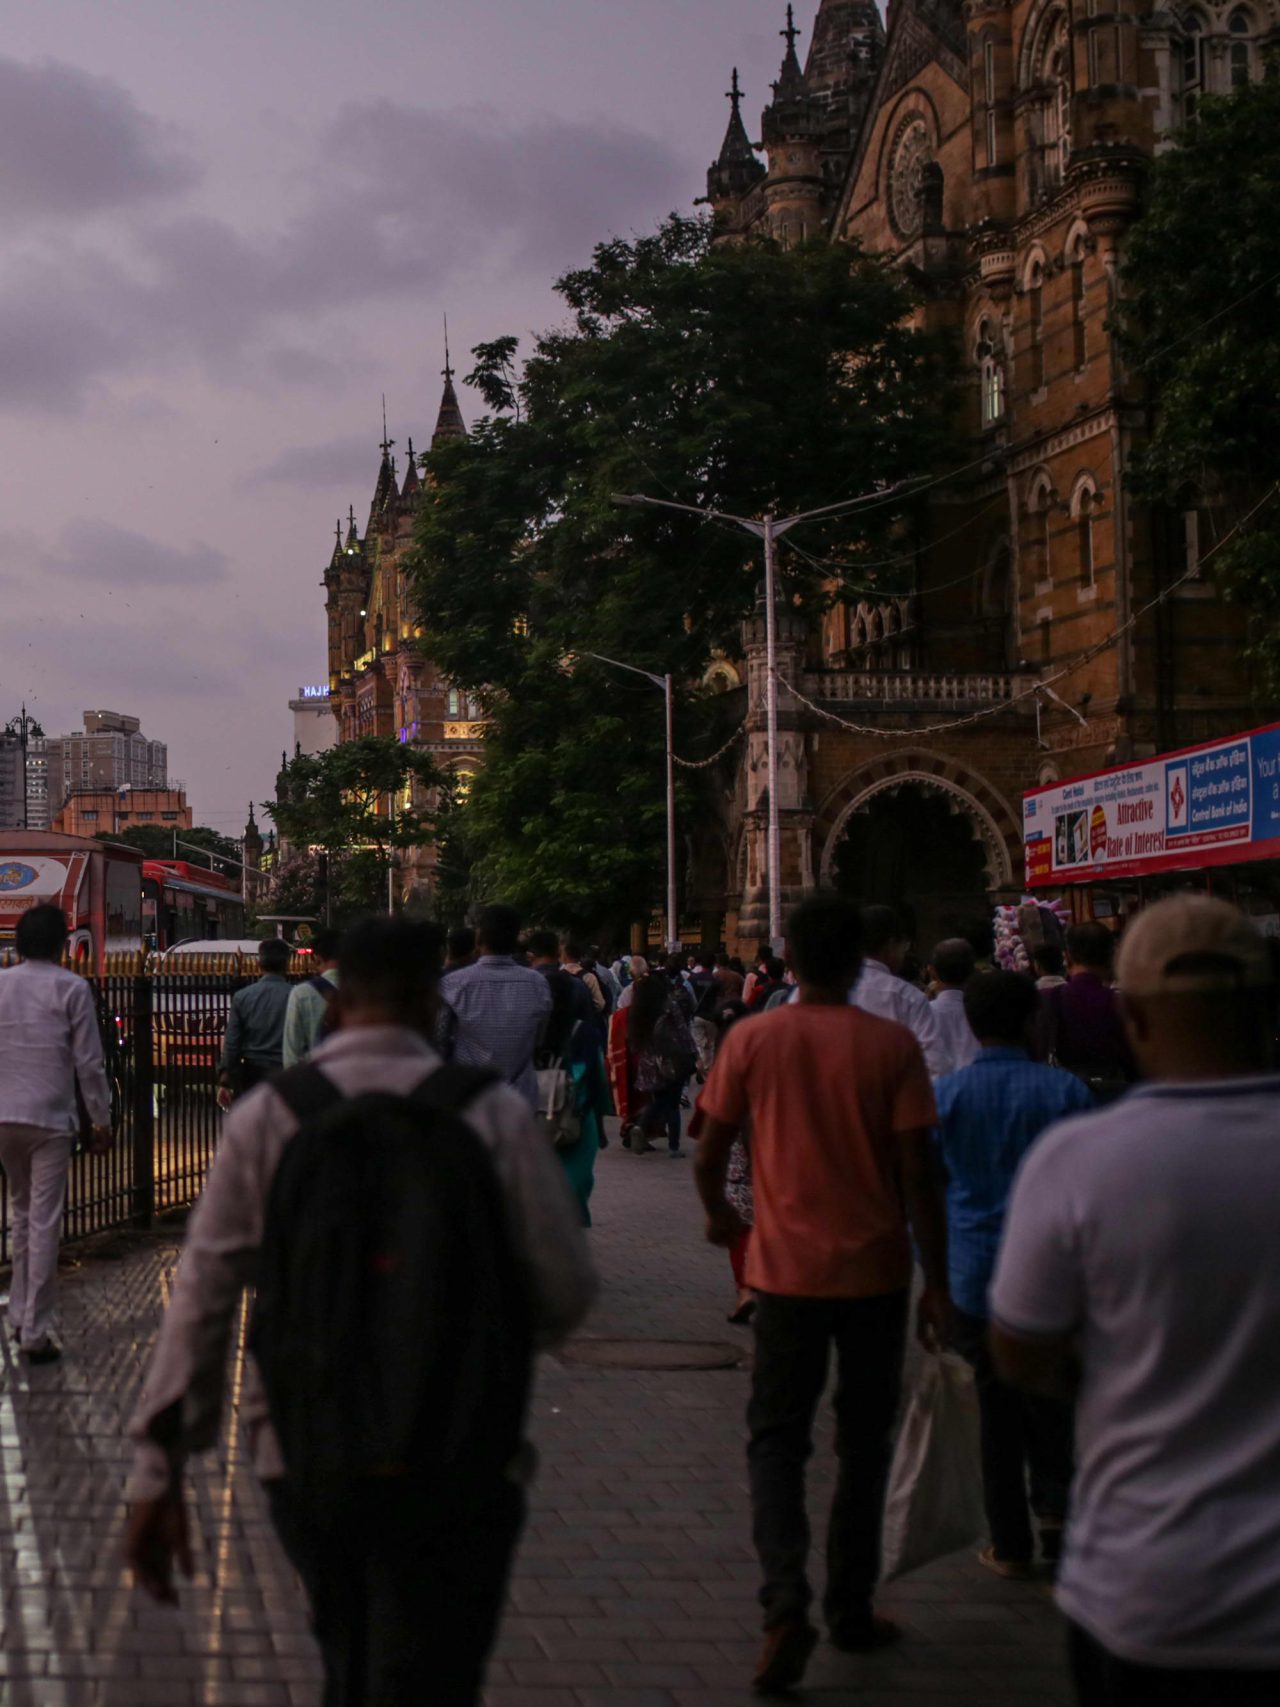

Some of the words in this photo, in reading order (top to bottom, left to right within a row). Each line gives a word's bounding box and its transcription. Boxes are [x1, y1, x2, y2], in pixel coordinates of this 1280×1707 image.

[304, 686, 321, 697] HAJ
[1257, 756, 1276, 778] Your
[1117, 799, 1153, 825] Attractive
[1192, 804, 1211, 822] Central
[1211, 802, 1225, 820] Bank
[1233, 798, 1248, 814] India
[1107, 836, 1123, 858] Rate
[1124, 833, 1133, 856] of
[1134, 828, 1165, 855] Interest
